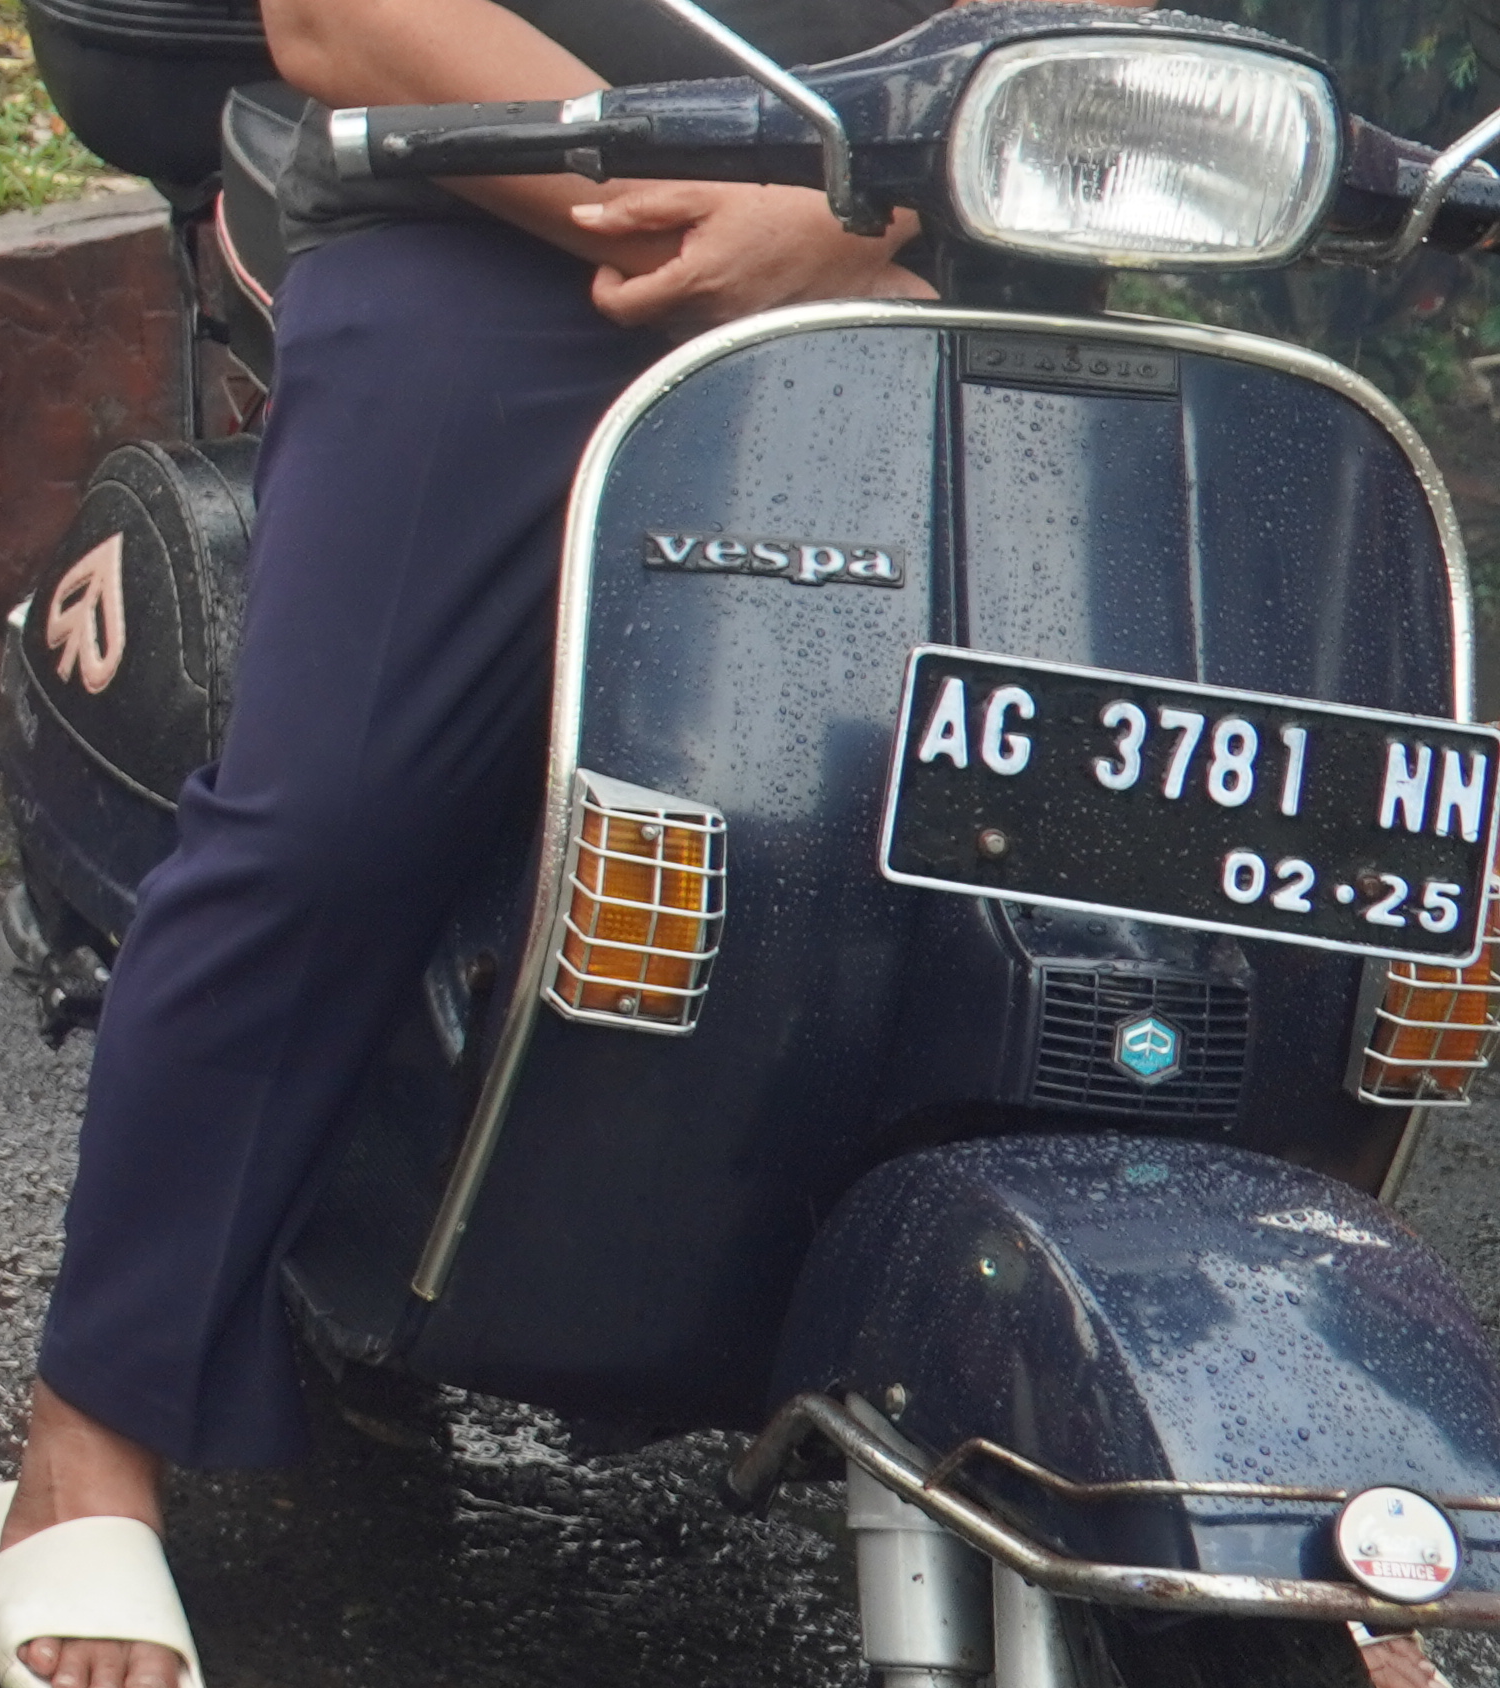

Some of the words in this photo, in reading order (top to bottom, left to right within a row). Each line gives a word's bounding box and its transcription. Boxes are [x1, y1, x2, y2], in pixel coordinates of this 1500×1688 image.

[650, 532, 895, 584] vespa
[918, 676, 1037, 777] AG
[1093, 701, 1308, 817] 3781
[1378, 741, 1487, 843] NN
[1373, 1561, 1437, 1581] SERVICE
